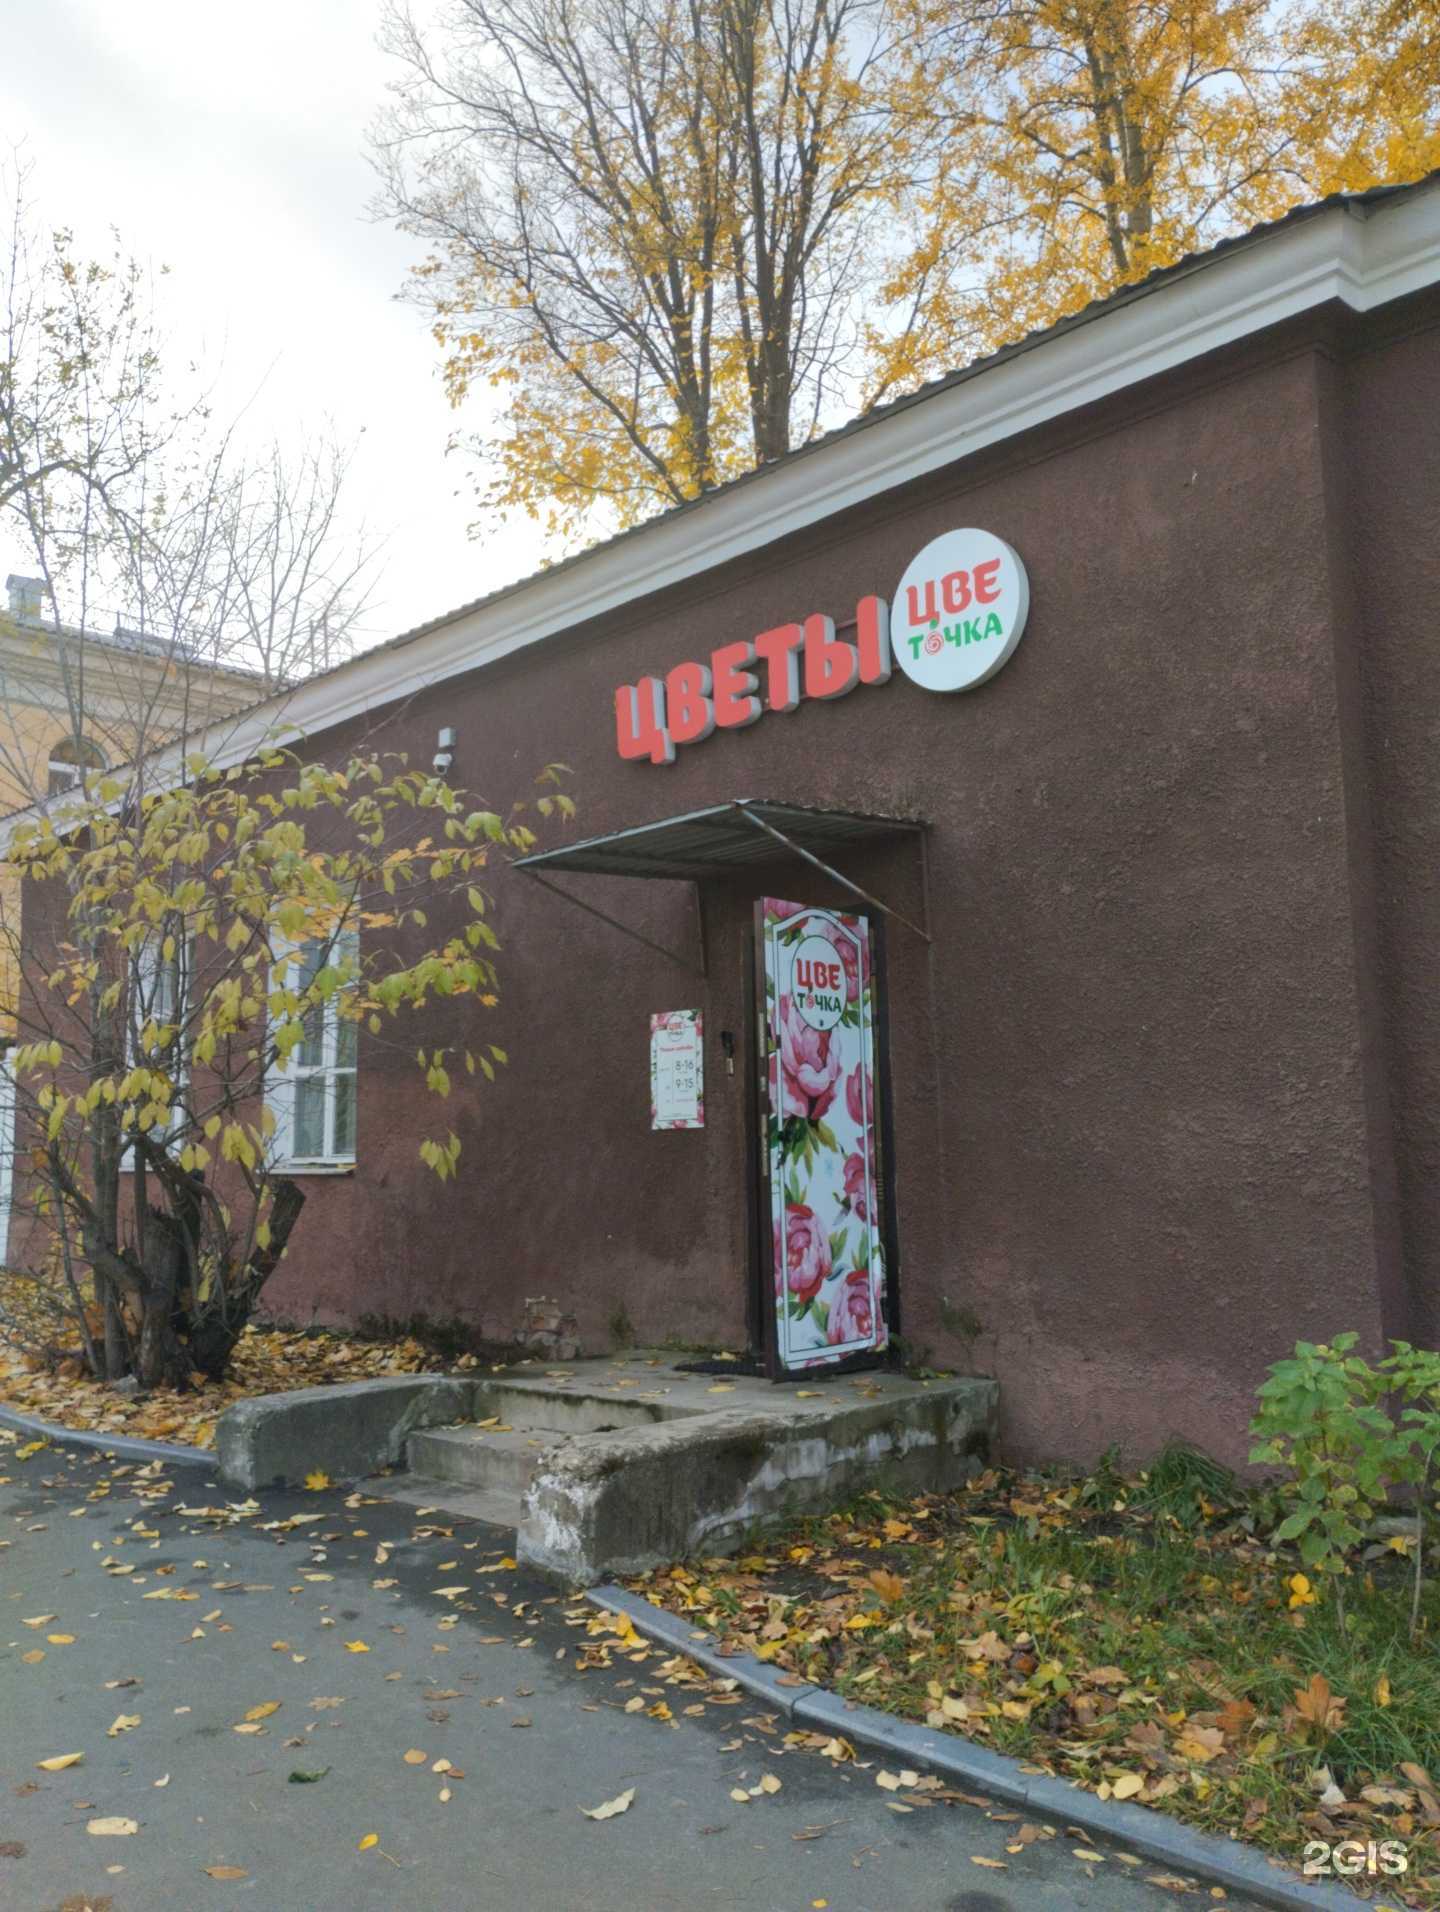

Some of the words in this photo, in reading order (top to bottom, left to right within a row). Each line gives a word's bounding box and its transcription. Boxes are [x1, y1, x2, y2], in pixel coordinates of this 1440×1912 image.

[906, 558, 1003, 627] ЦВЕ
[908, 612, 1004, 660] ТОЧКА
[615, 595, 892, 765] ЦВЕТЫ
[796, 958, 841, 991] ЦВЕ
[797, 992, 842, 1013] ТОЧКА
